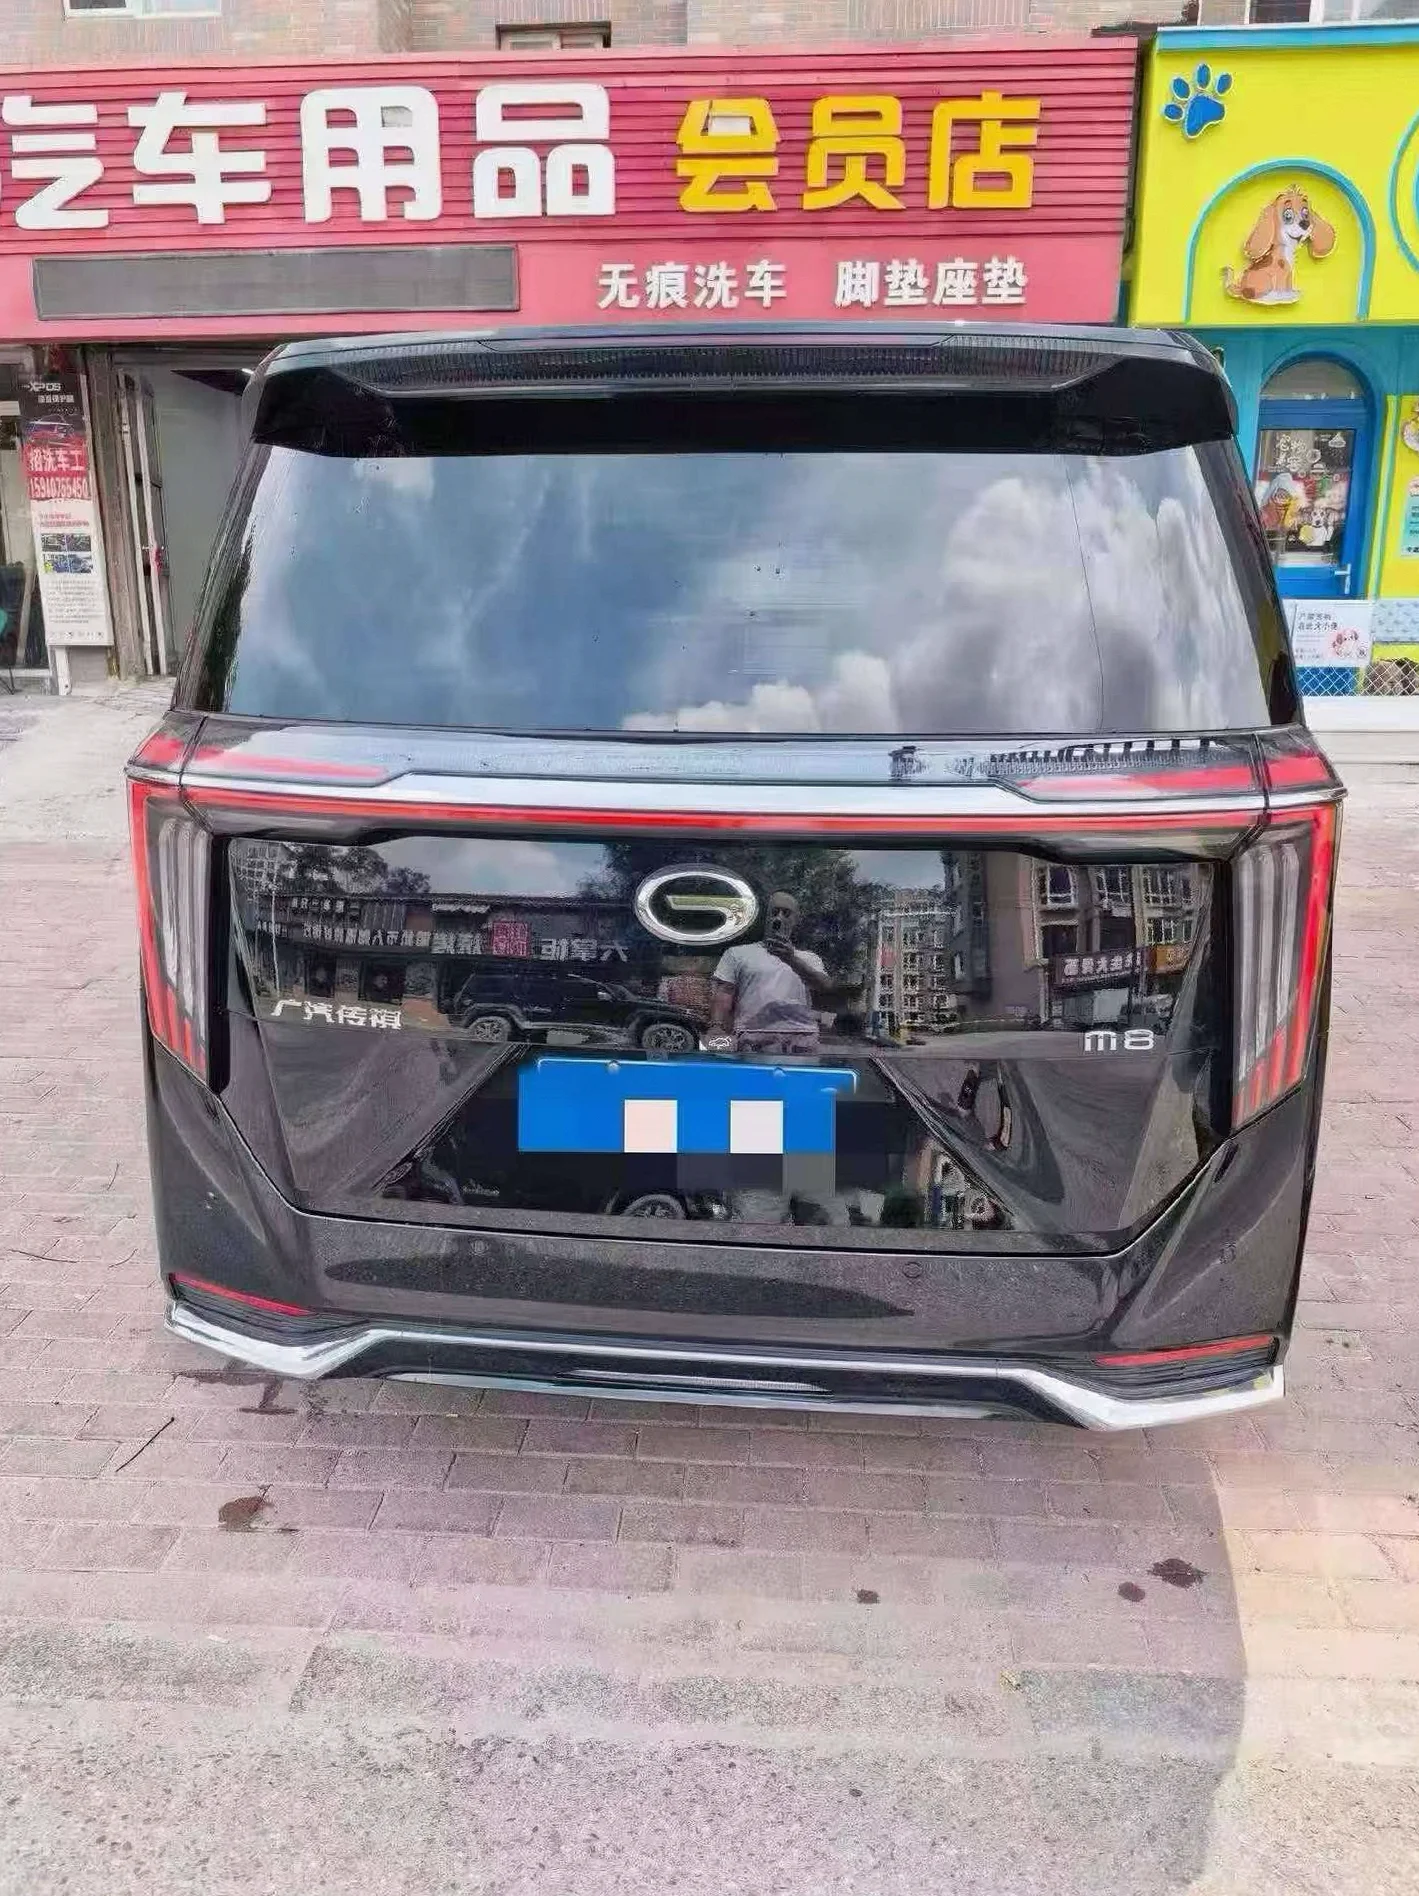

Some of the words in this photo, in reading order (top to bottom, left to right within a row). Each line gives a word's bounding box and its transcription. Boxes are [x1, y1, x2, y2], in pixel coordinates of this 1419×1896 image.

[675, 89, 1042, 213] 会员店
[597, 260, 788, 309] 无痕洗车
[834, 255, 1029, 308] 脚垫座垫
[270, 999, 402, 1031] 广汽传祺
